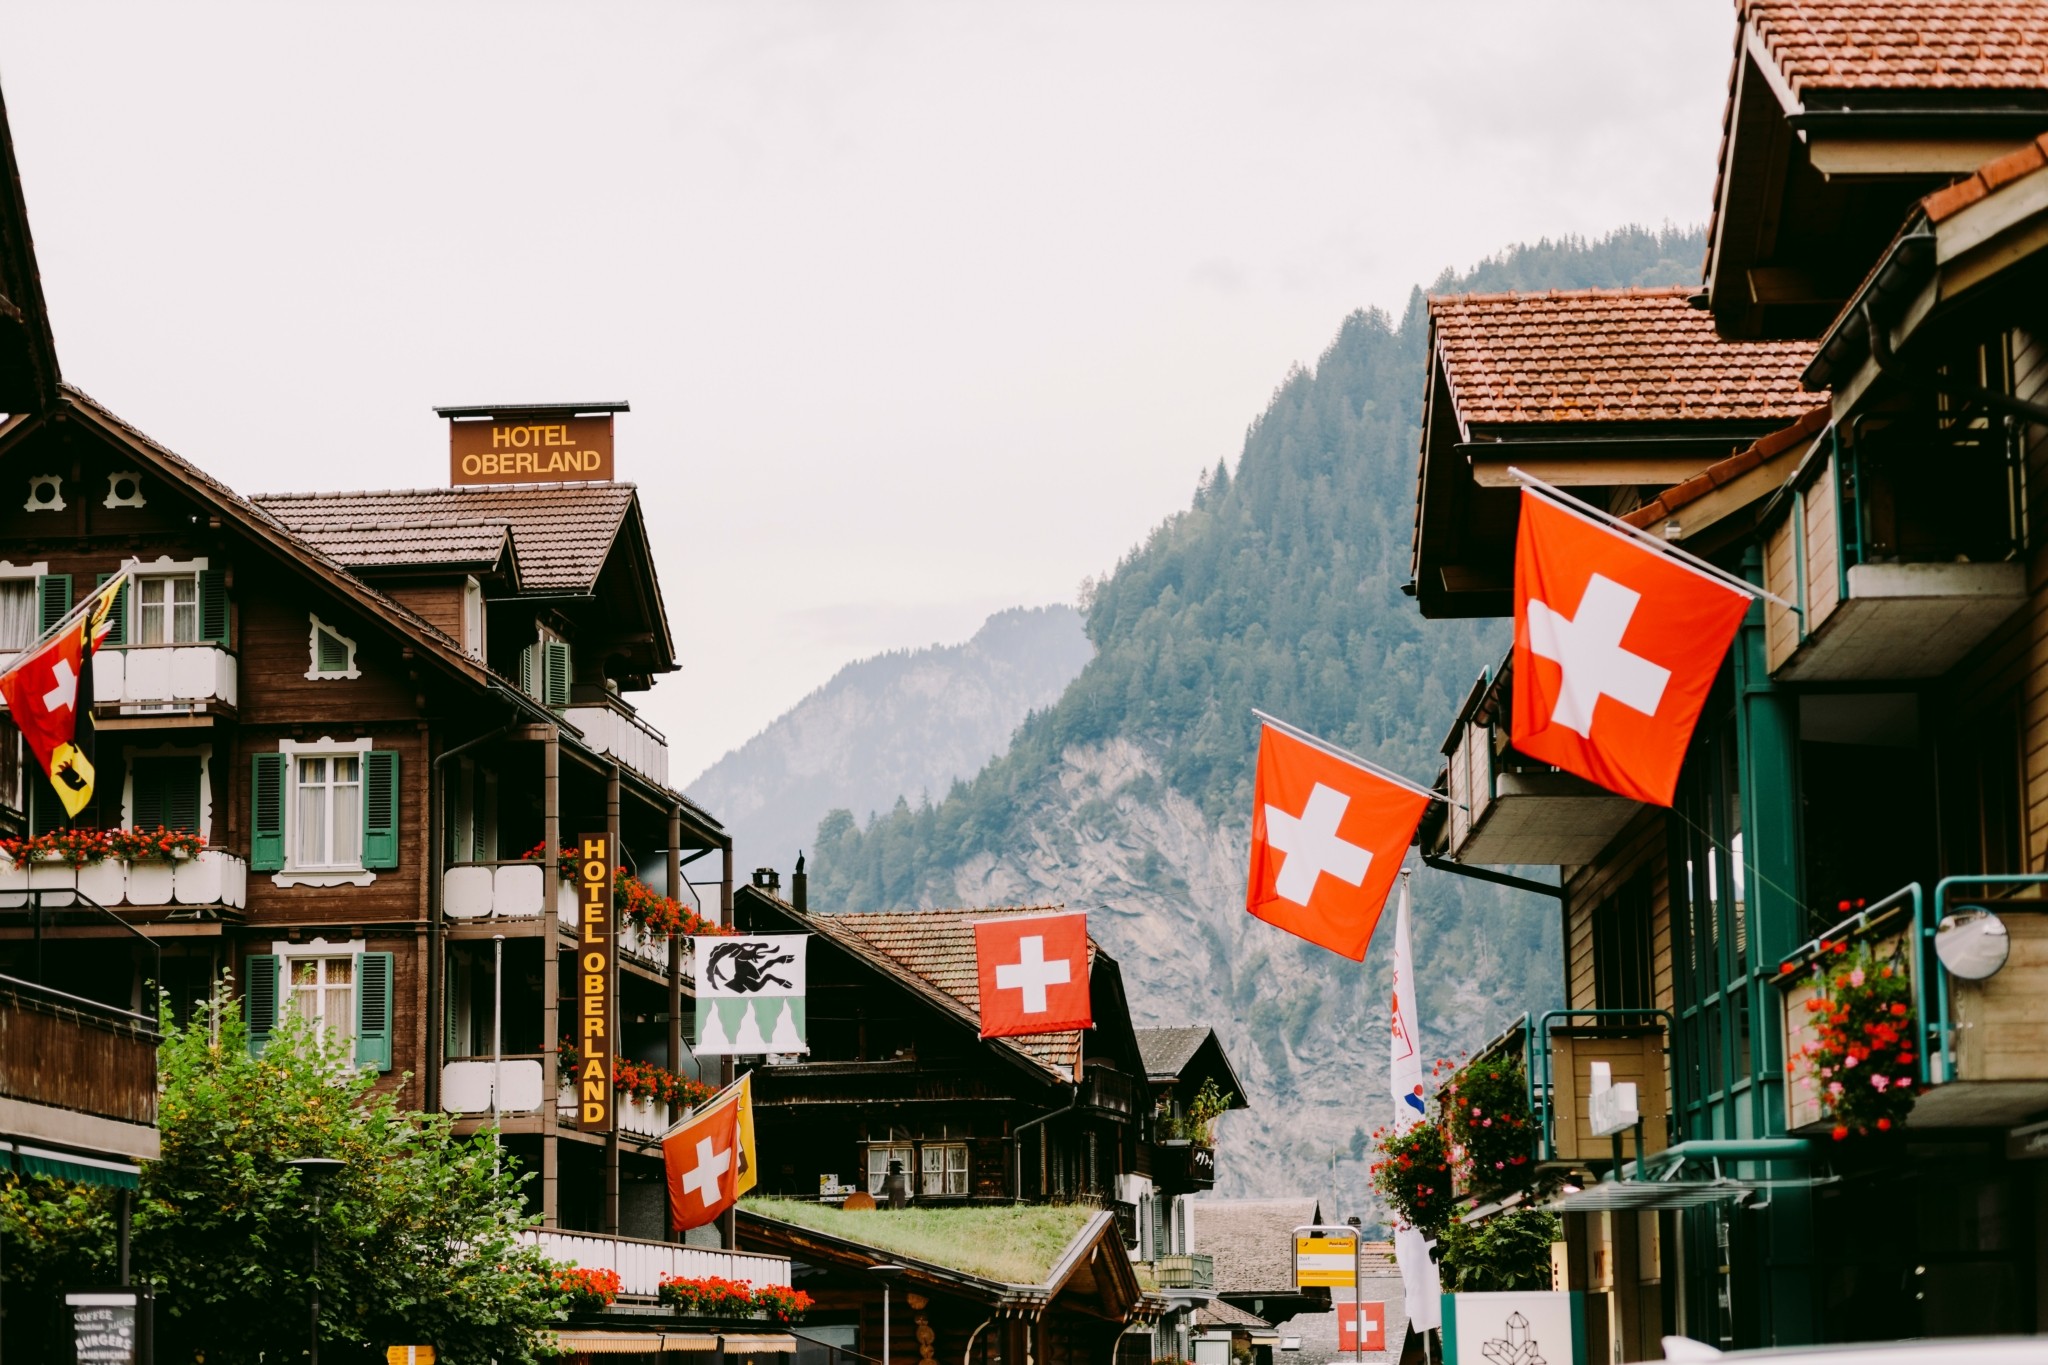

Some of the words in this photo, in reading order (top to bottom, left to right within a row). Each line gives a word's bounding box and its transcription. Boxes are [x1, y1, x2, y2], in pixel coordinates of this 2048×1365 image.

[492, 425, 576, 448] HOTEL
[461, 450, 601, 476] OBERLAND
[583, 839, 606, 943] HOTEL
[583, 952, 606, 1123] OBERLAND
[74, 1309, 113, 1322] COFFEE
[75, 1333, 132, 1350] BURGERS
